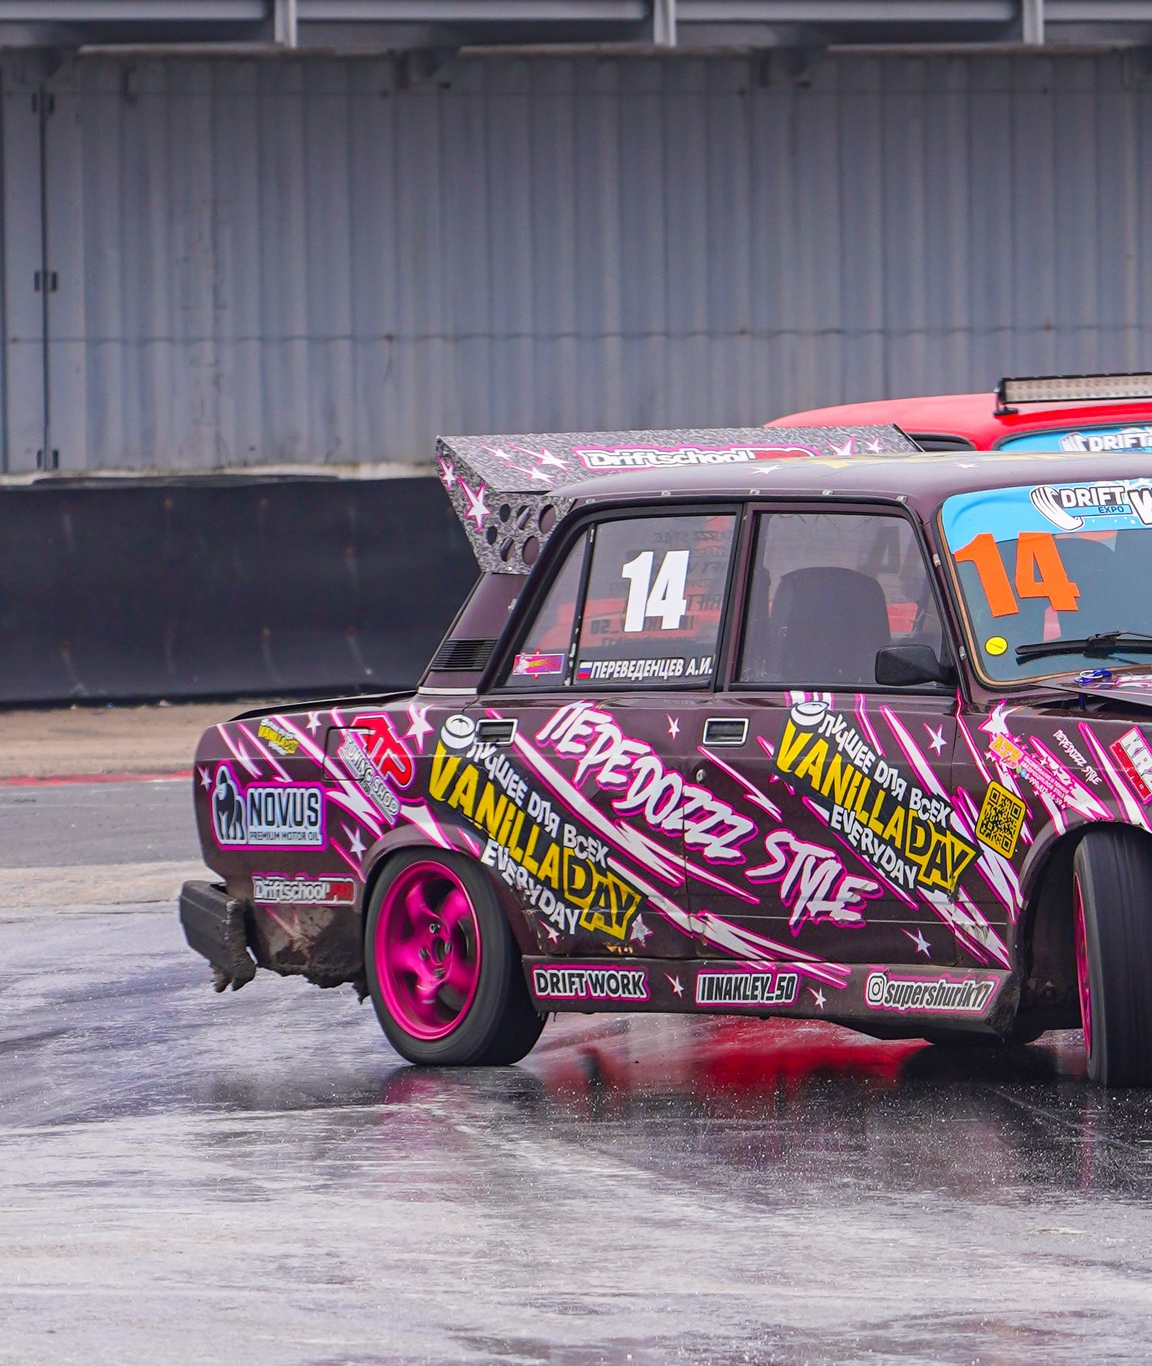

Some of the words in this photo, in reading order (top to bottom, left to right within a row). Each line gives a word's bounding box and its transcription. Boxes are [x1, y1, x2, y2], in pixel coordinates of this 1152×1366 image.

[1088, 432, 1150, 451] DRIFT
[1059, 486, 1126, 508] DRIFT
[1098, 505, 1125, 514] EXPO
[621, 549, 690, 633] 14
[953, 532, 1080, 618] 14
[591, 659, 684, 681] ПЕРЕВЕДЕНЦЕВ
[249, 791, 320, 828] NOVUS
[249, 831, 281, 841] PREMIUM
[281, 831, 308, 841] MOTOR
[308, 831, 321, 841] OIL
[831, 804, 919, 890] EVERYDAY
[480, 838, 580, 935] EVERYDAY
[745, 831, 880, 929] STYLE
